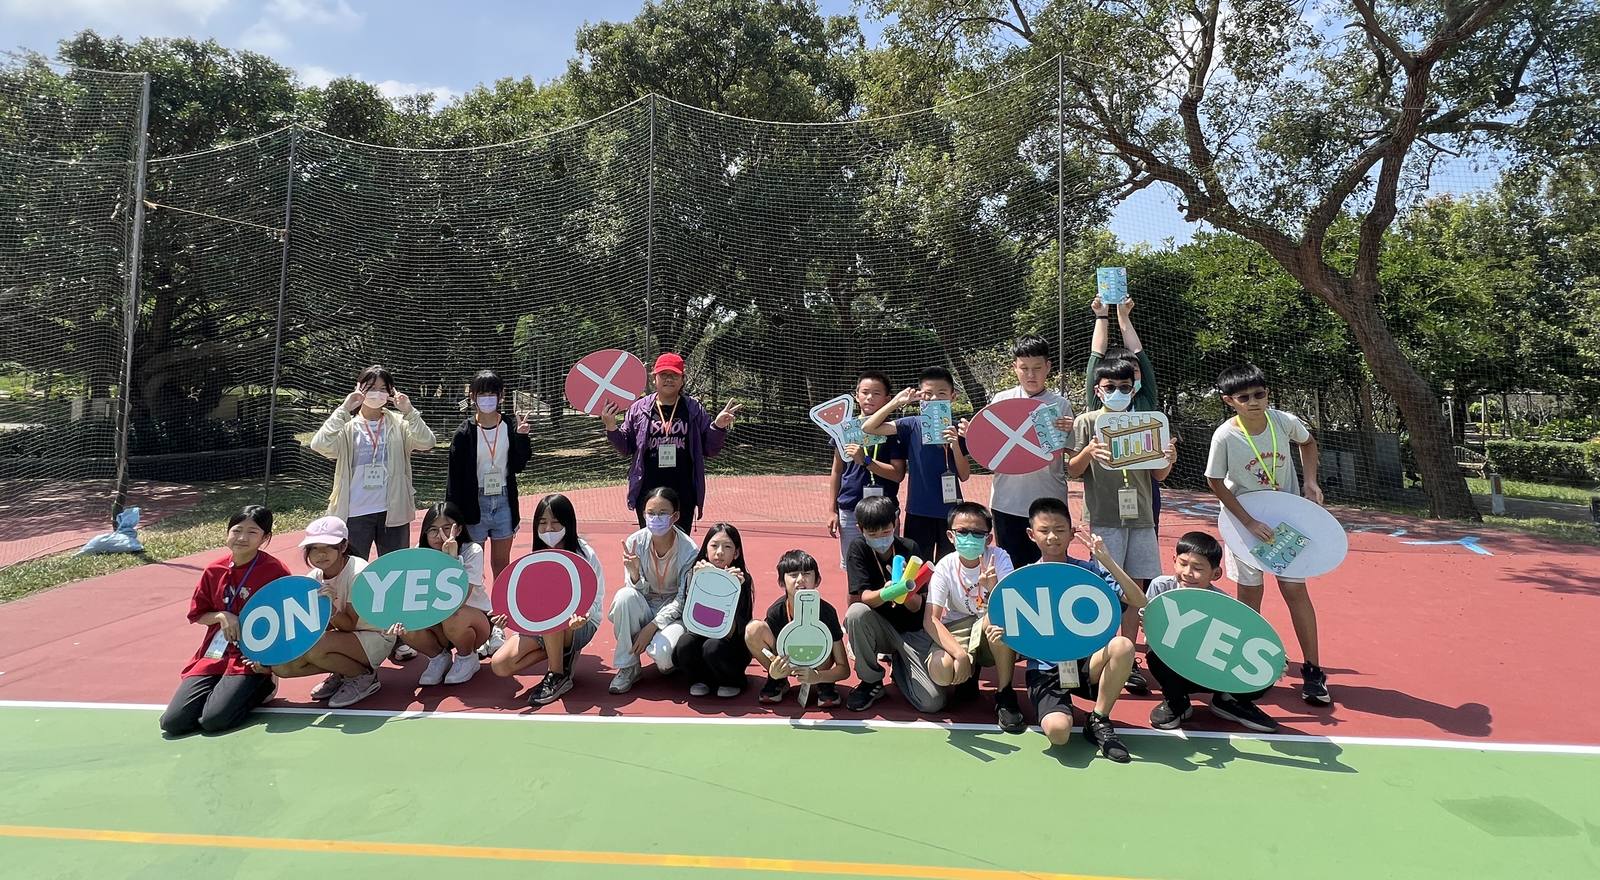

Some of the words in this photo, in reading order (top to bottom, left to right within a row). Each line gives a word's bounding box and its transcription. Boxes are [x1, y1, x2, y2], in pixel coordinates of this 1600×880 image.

[1265, 531, 1296, 561] NOTEBOOK
[362, 568, 464, 613] YES
[1001, 584, 1113, 637] NO
[1160, 595, 1282, 687] YES
